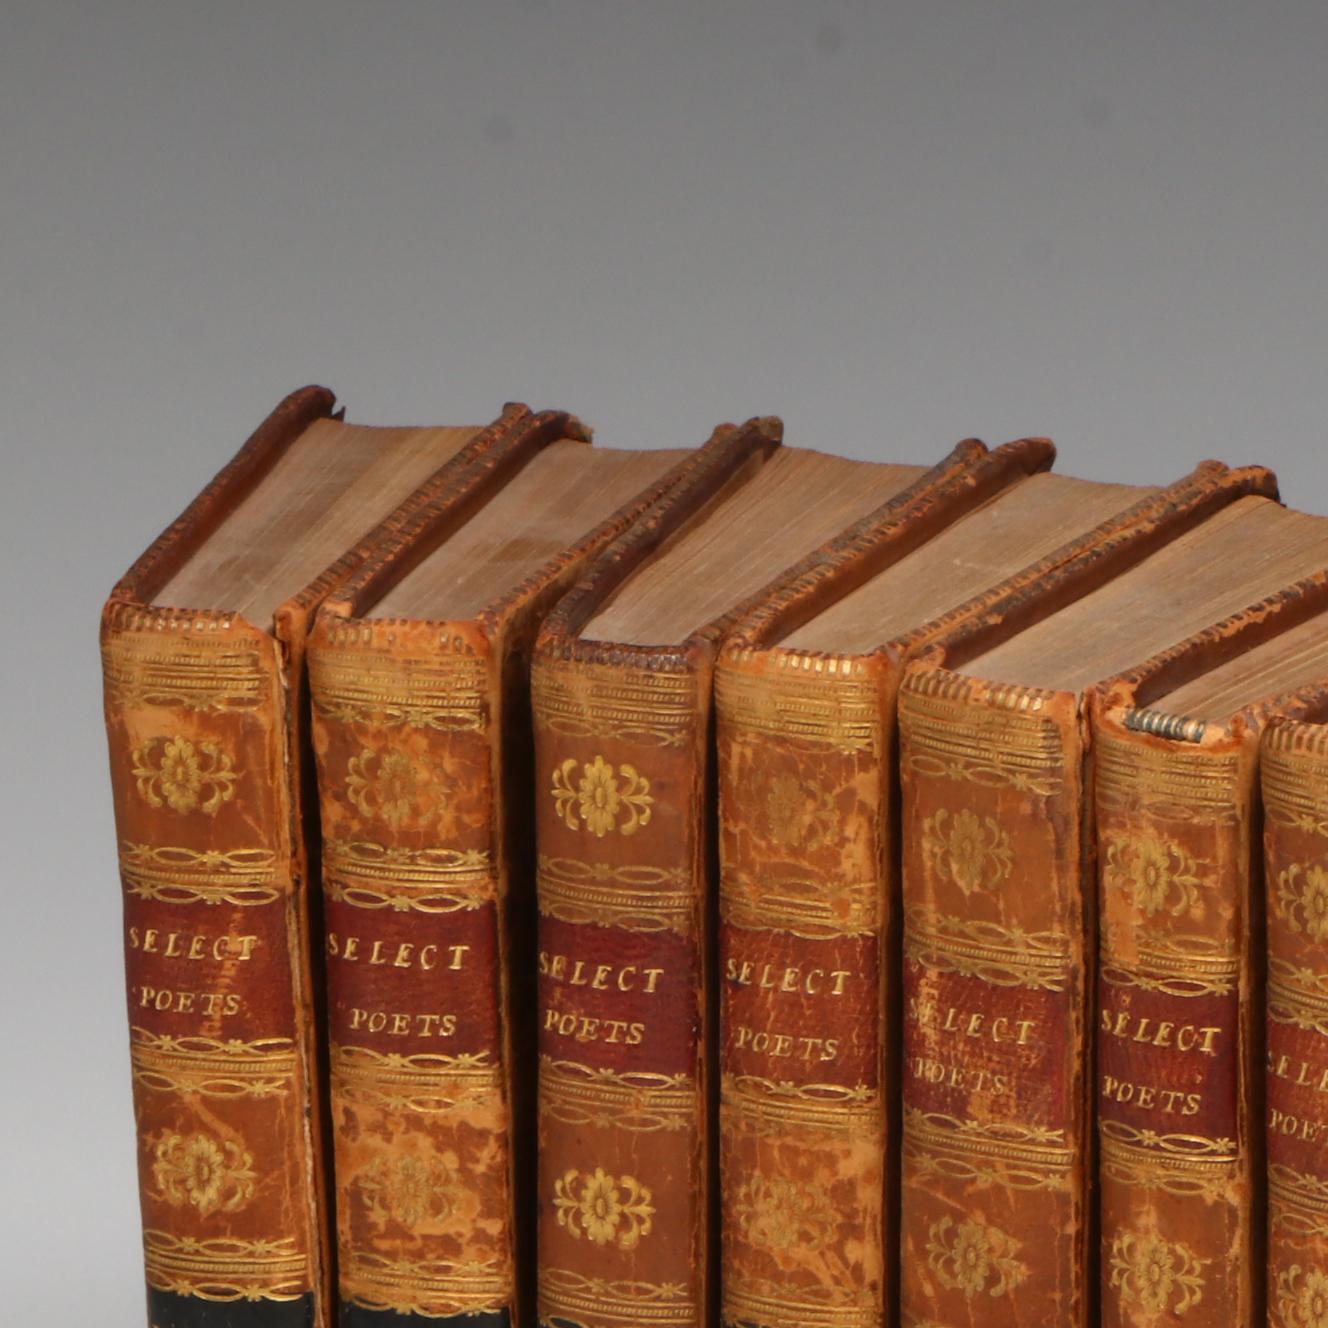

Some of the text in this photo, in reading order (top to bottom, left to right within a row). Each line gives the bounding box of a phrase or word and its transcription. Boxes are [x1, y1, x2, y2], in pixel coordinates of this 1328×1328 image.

[130, 926, 259, 962] SELECT
[328, 932, 471, 971] SELECT
[539, 951, 665, 994] SELECT
[726, 957, 852, 996] SELECT
[139, 985, 242, 1017] POETS
[350, 1007, 458, 1038] POETS
[544, 1008, 646, 1046] POETS
[1100, 1007, 1223, 1054] SELECT
[735, 1025, 840, 1062] POETS
[913, 1056, 1010, 1097] POETS
[1102, 1074, 1202, 1116] POETS
